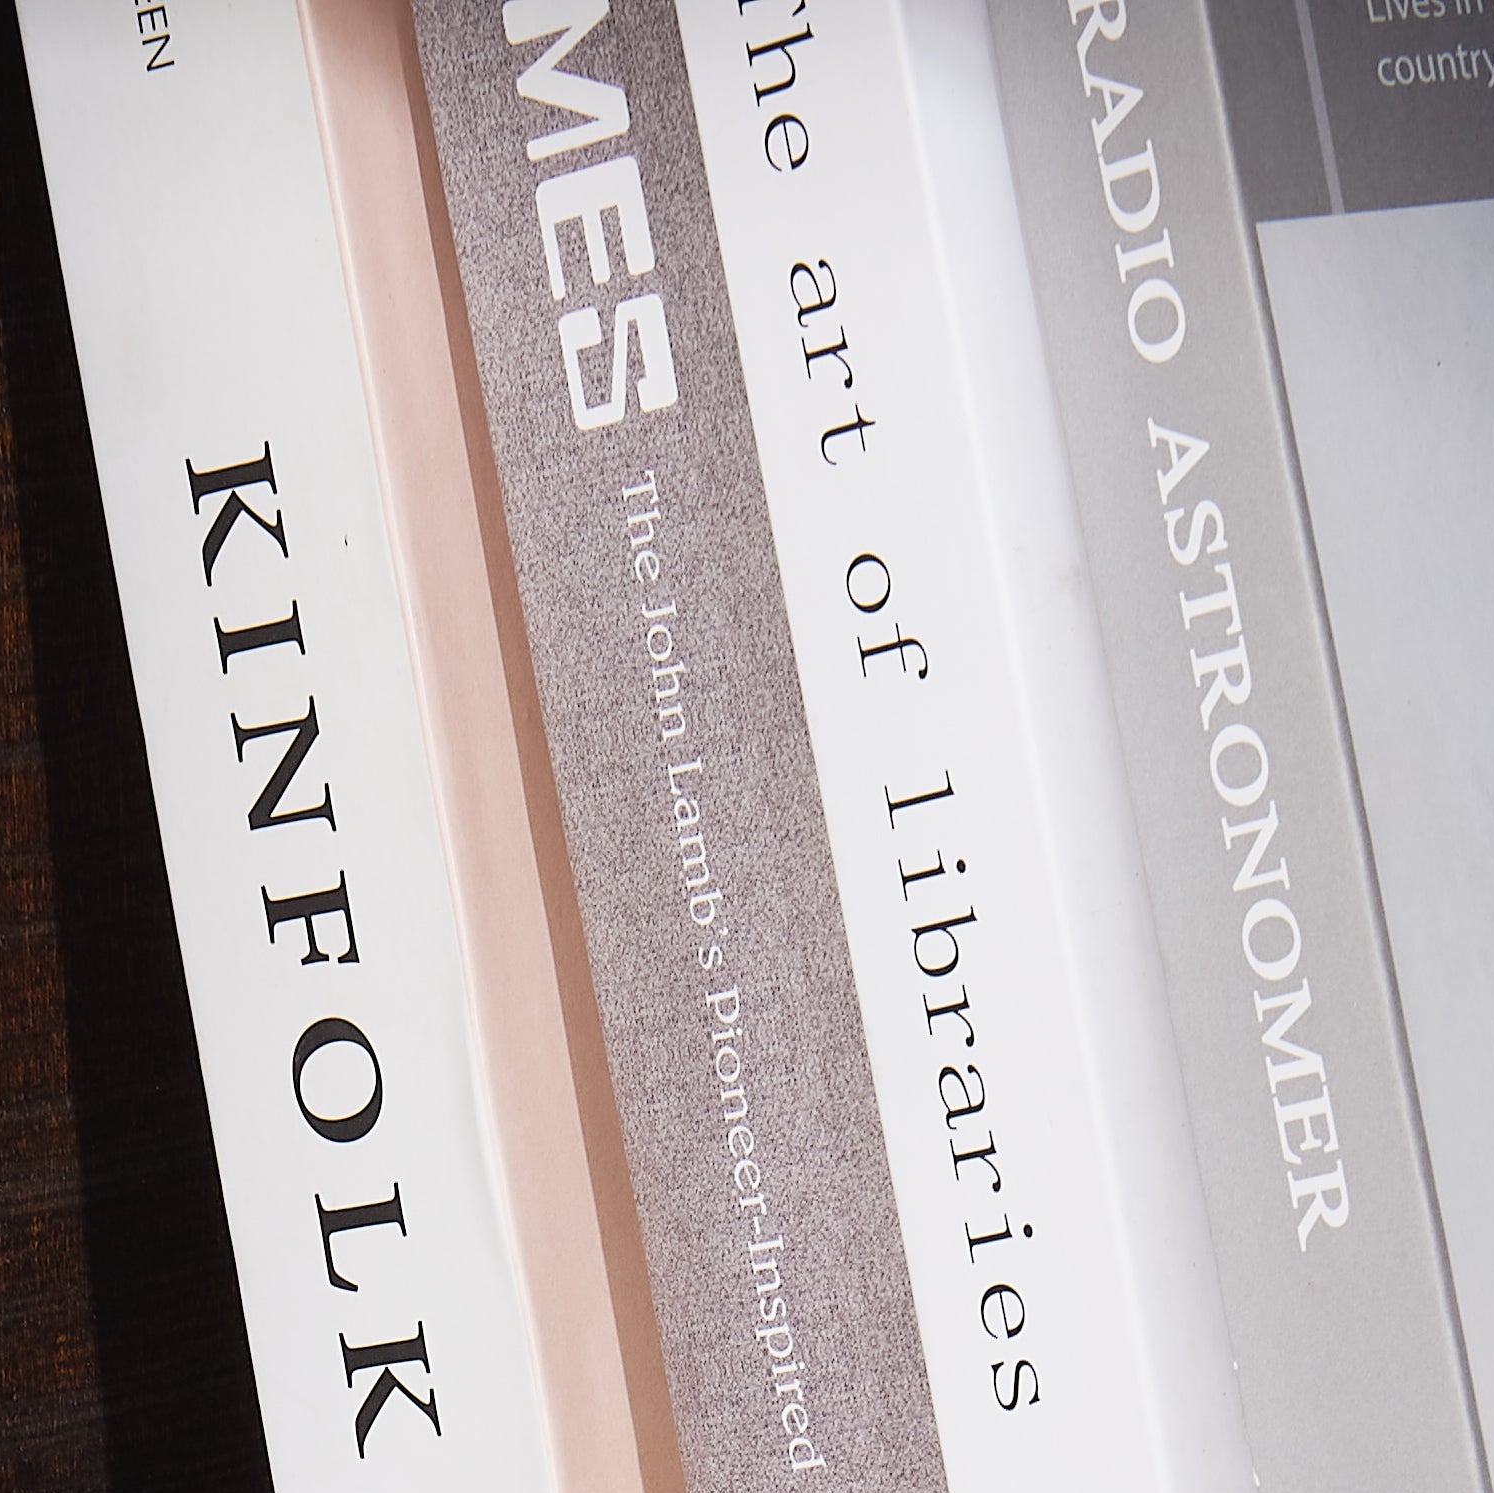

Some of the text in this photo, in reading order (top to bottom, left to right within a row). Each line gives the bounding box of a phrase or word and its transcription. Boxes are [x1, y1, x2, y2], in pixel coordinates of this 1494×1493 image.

[135, 0, 175, 72] EN
[185, 439, 442, 1460] KINFOLK
[622, 469, 827, 1472] The John Lamb's Pioneer-Inspired
[737, 0, 1041, 1412] he art of libraries
[1067, 0, 1350, 1252] RADIO ASTRONOMER
